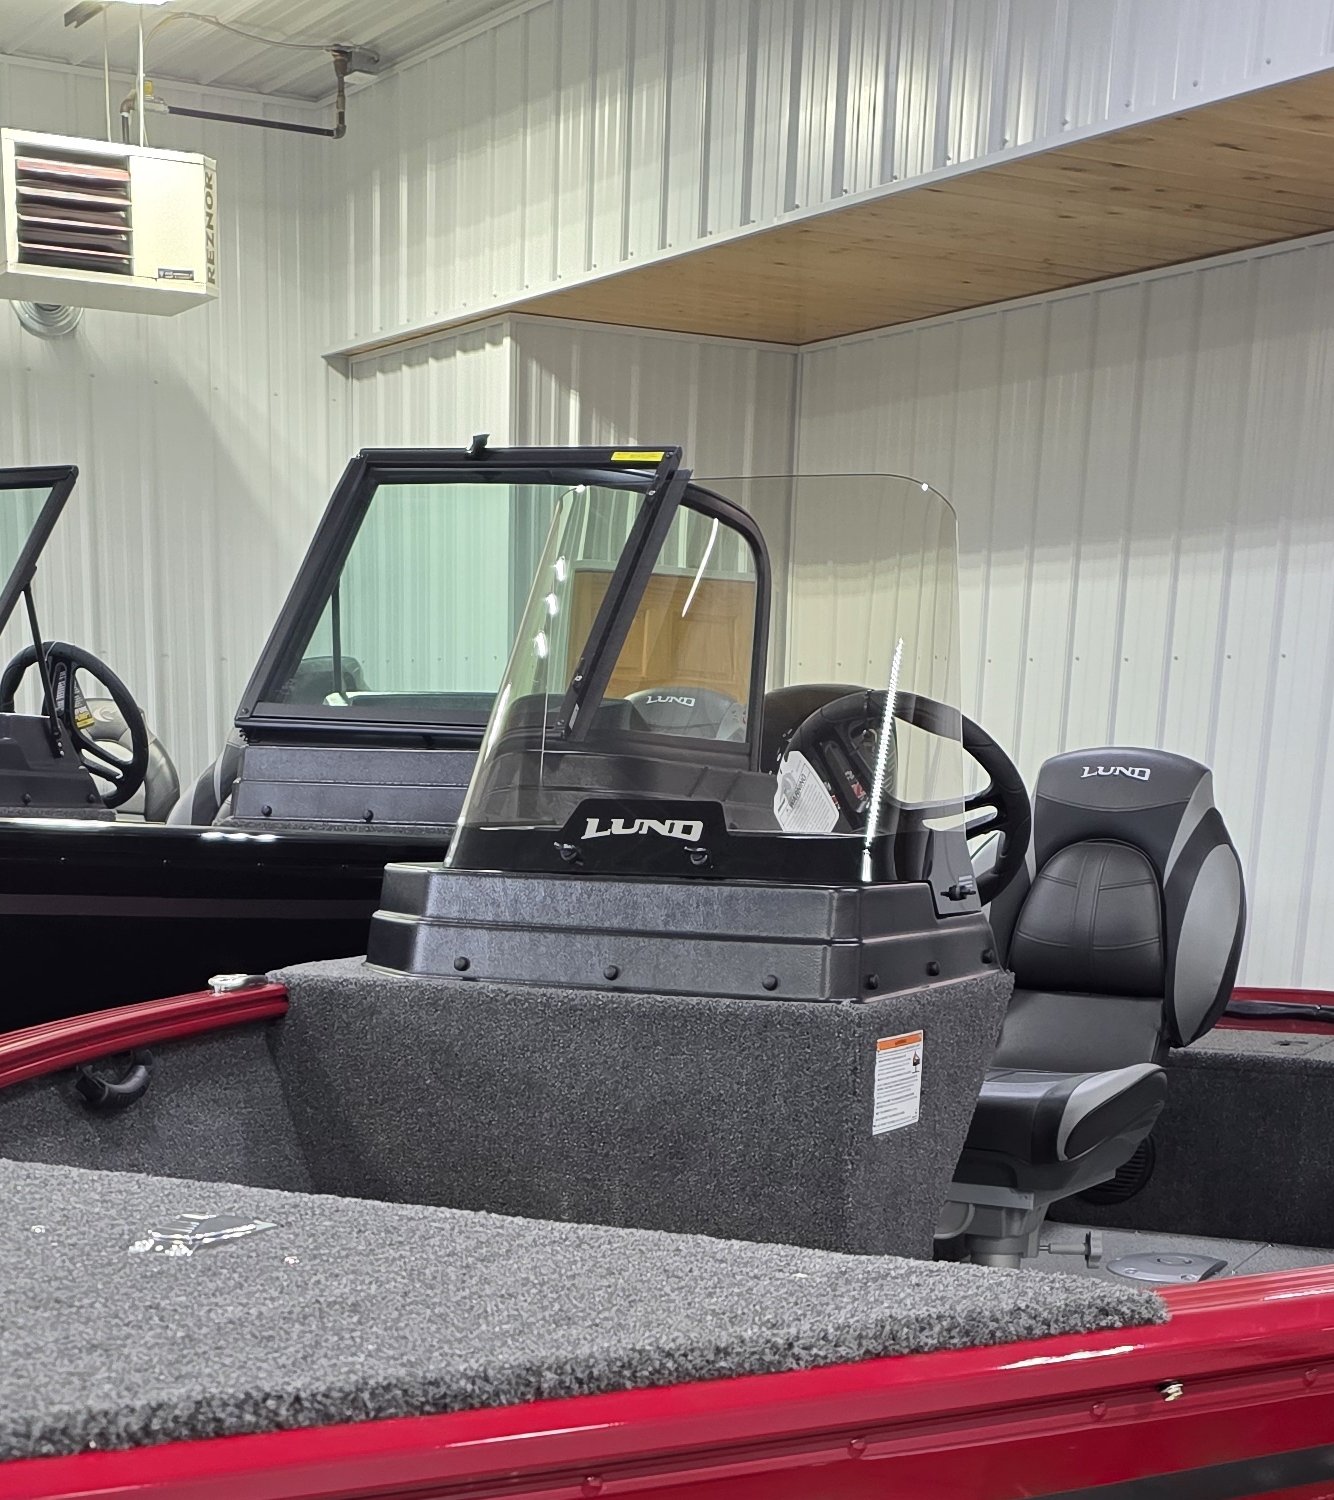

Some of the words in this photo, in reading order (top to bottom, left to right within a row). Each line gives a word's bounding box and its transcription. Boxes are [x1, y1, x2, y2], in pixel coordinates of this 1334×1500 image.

[204, 171, 217, 285] REZNOR
[646, 695, 696, 708] LUND
[1080, 766, 1151, 781] LUND
[581, 817, 704, 842] LUND
